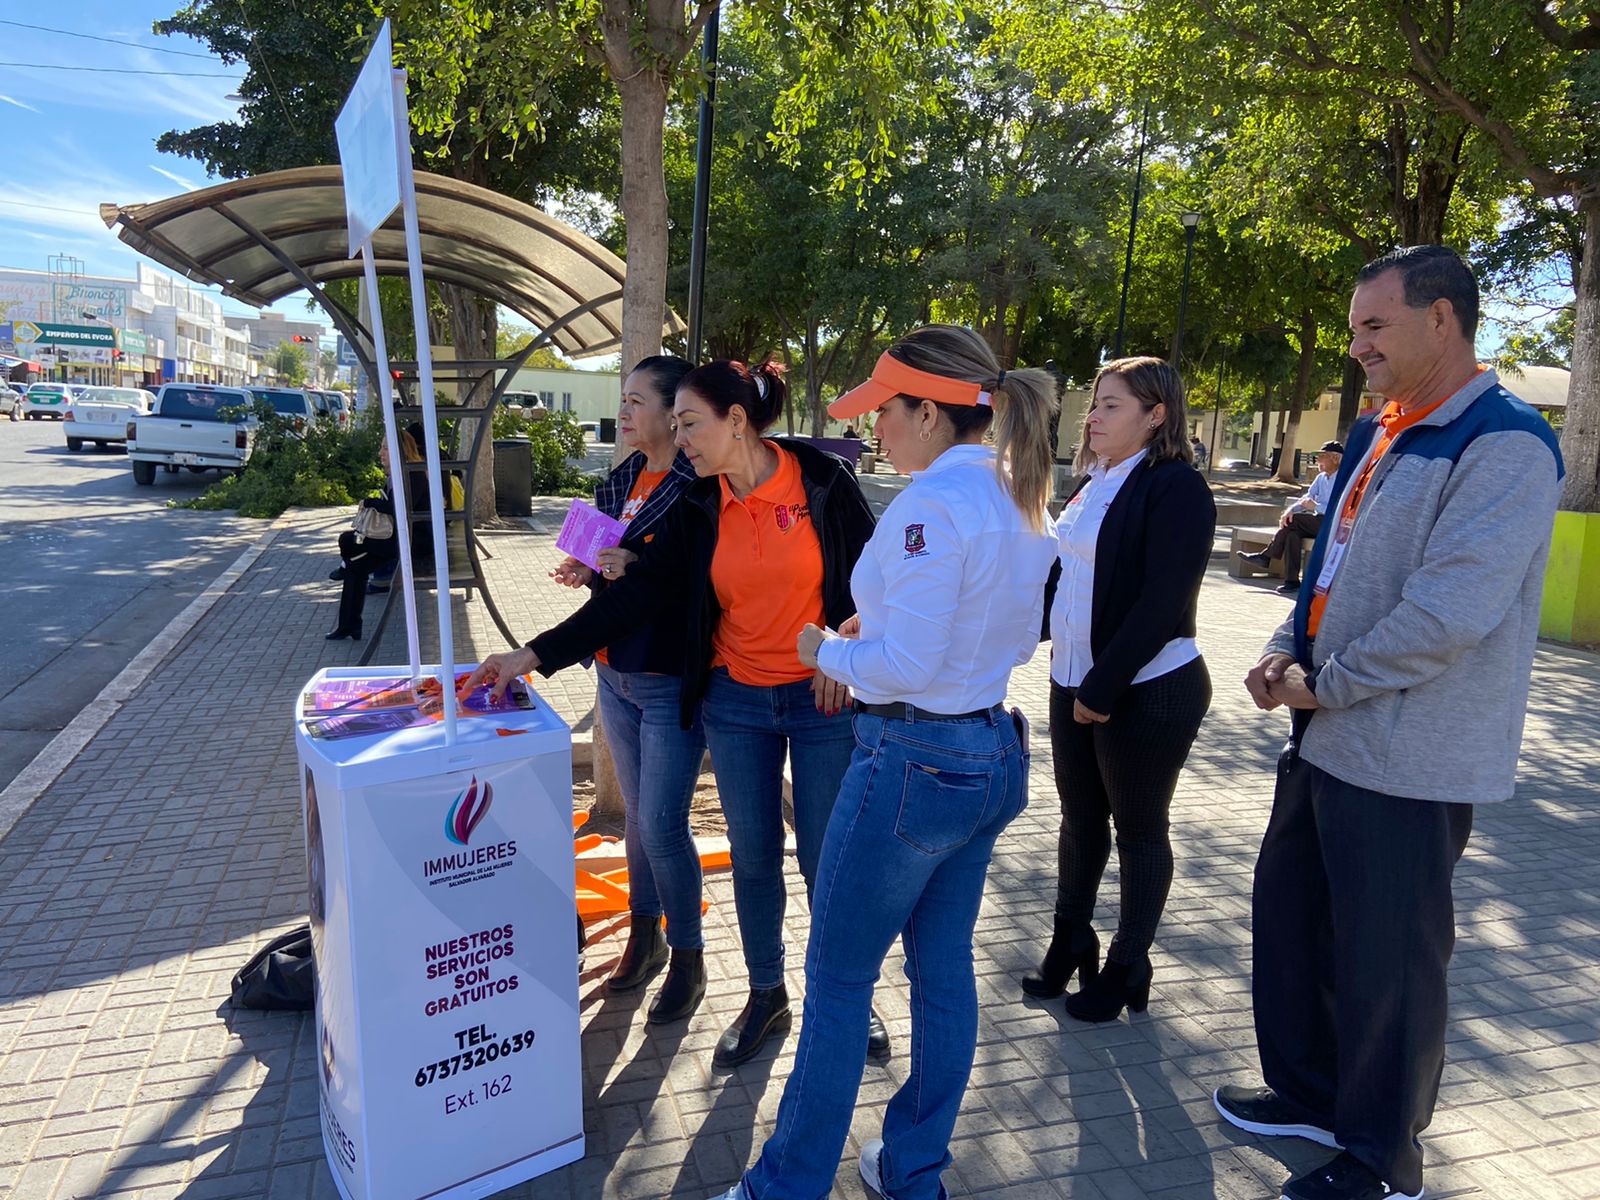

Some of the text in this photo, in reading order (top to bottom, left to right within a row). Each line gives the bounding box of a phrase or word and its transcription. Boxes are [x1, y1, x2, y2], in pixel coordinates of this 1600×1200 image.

[424, 841, 517, 877] IMMUJERES
[429, 876, 452, 886] INSTITUTO
[452, 870, 476, 880] MUNICIPAL
[493, 861, 513, 870] MUJERES
[449, 871, 495, 888] SALVADOR ALVARADO
[425, 924, 514, 962] NUESTROS
[426, 941, 514, 980] SERVICIOS
[424, 975, 519, 1017] GRATUITOS
[454, 966, 489, 990] SON
[454, 1024, 497, 1050] TEL.
[414, 1029, 535, 1087] 6737320639
[445, 1074, 512, 1115] Ext. 162
